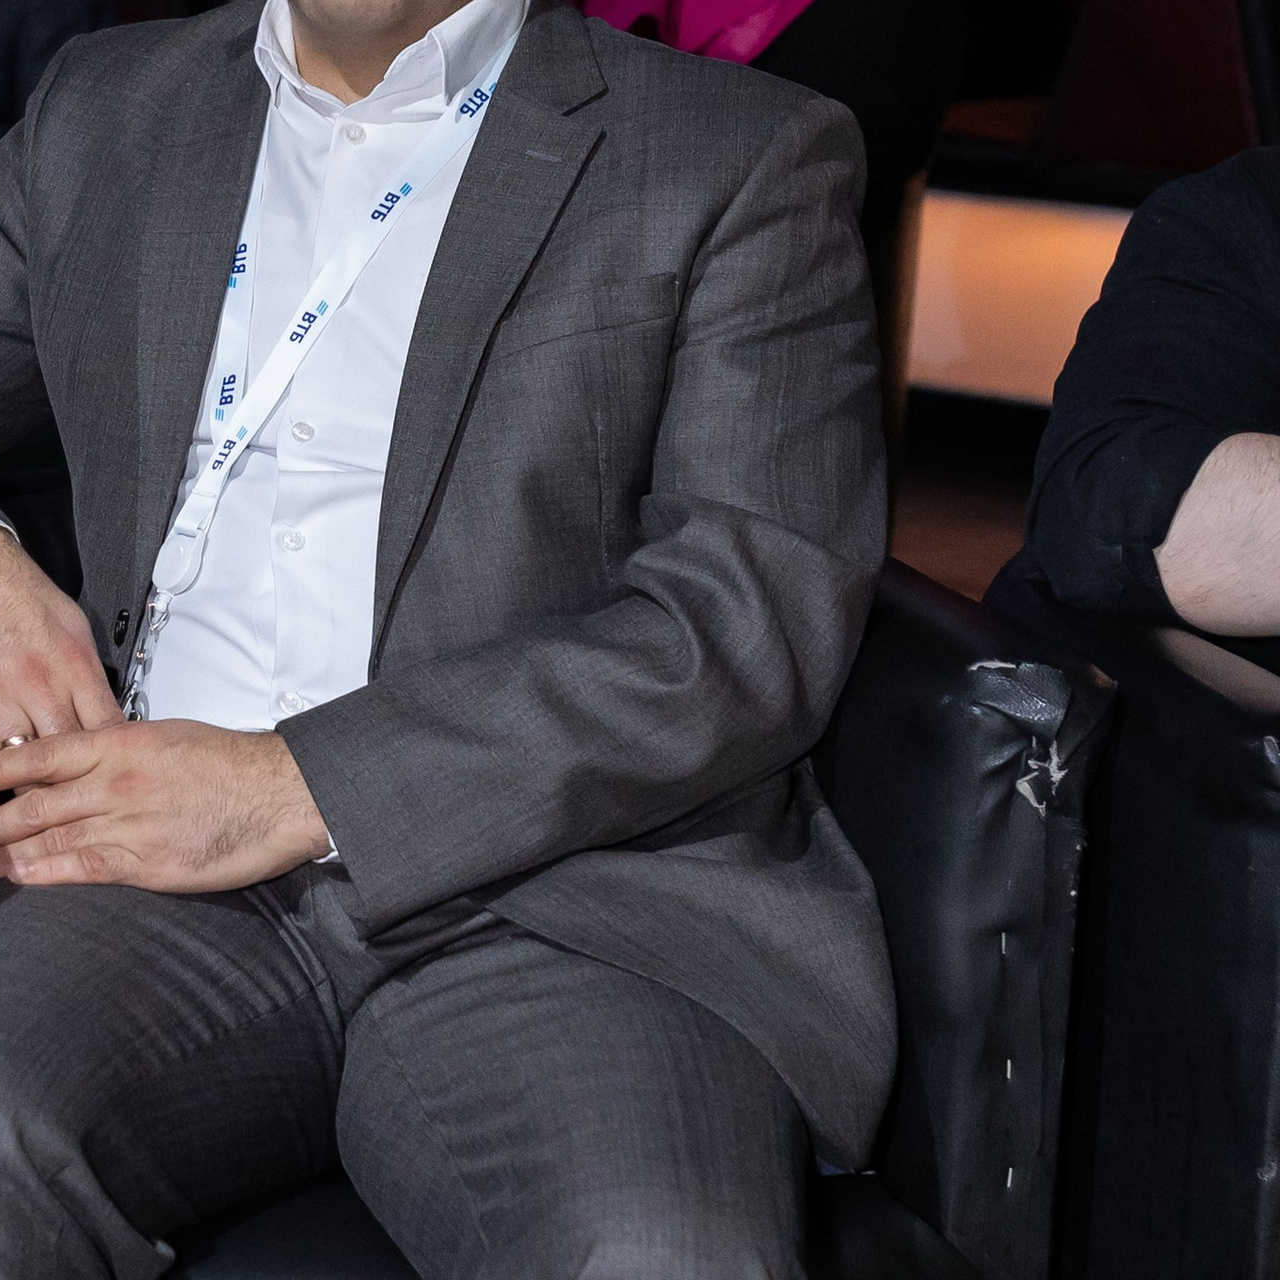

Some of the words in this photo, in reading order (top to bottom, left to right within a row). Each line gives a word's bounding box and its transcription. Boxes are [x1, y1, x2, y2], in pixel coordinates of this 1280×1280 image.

[460, 88, 490, 118] ВТБ
[371, 191, 401, 222] ВТБ
[231, 243, 247, 274] ВТБ
[289, 311, 318, 344] ВТБ
[219, 374, 236, 406] ВТБ
[212, 439, 237, 471] ВТБ
